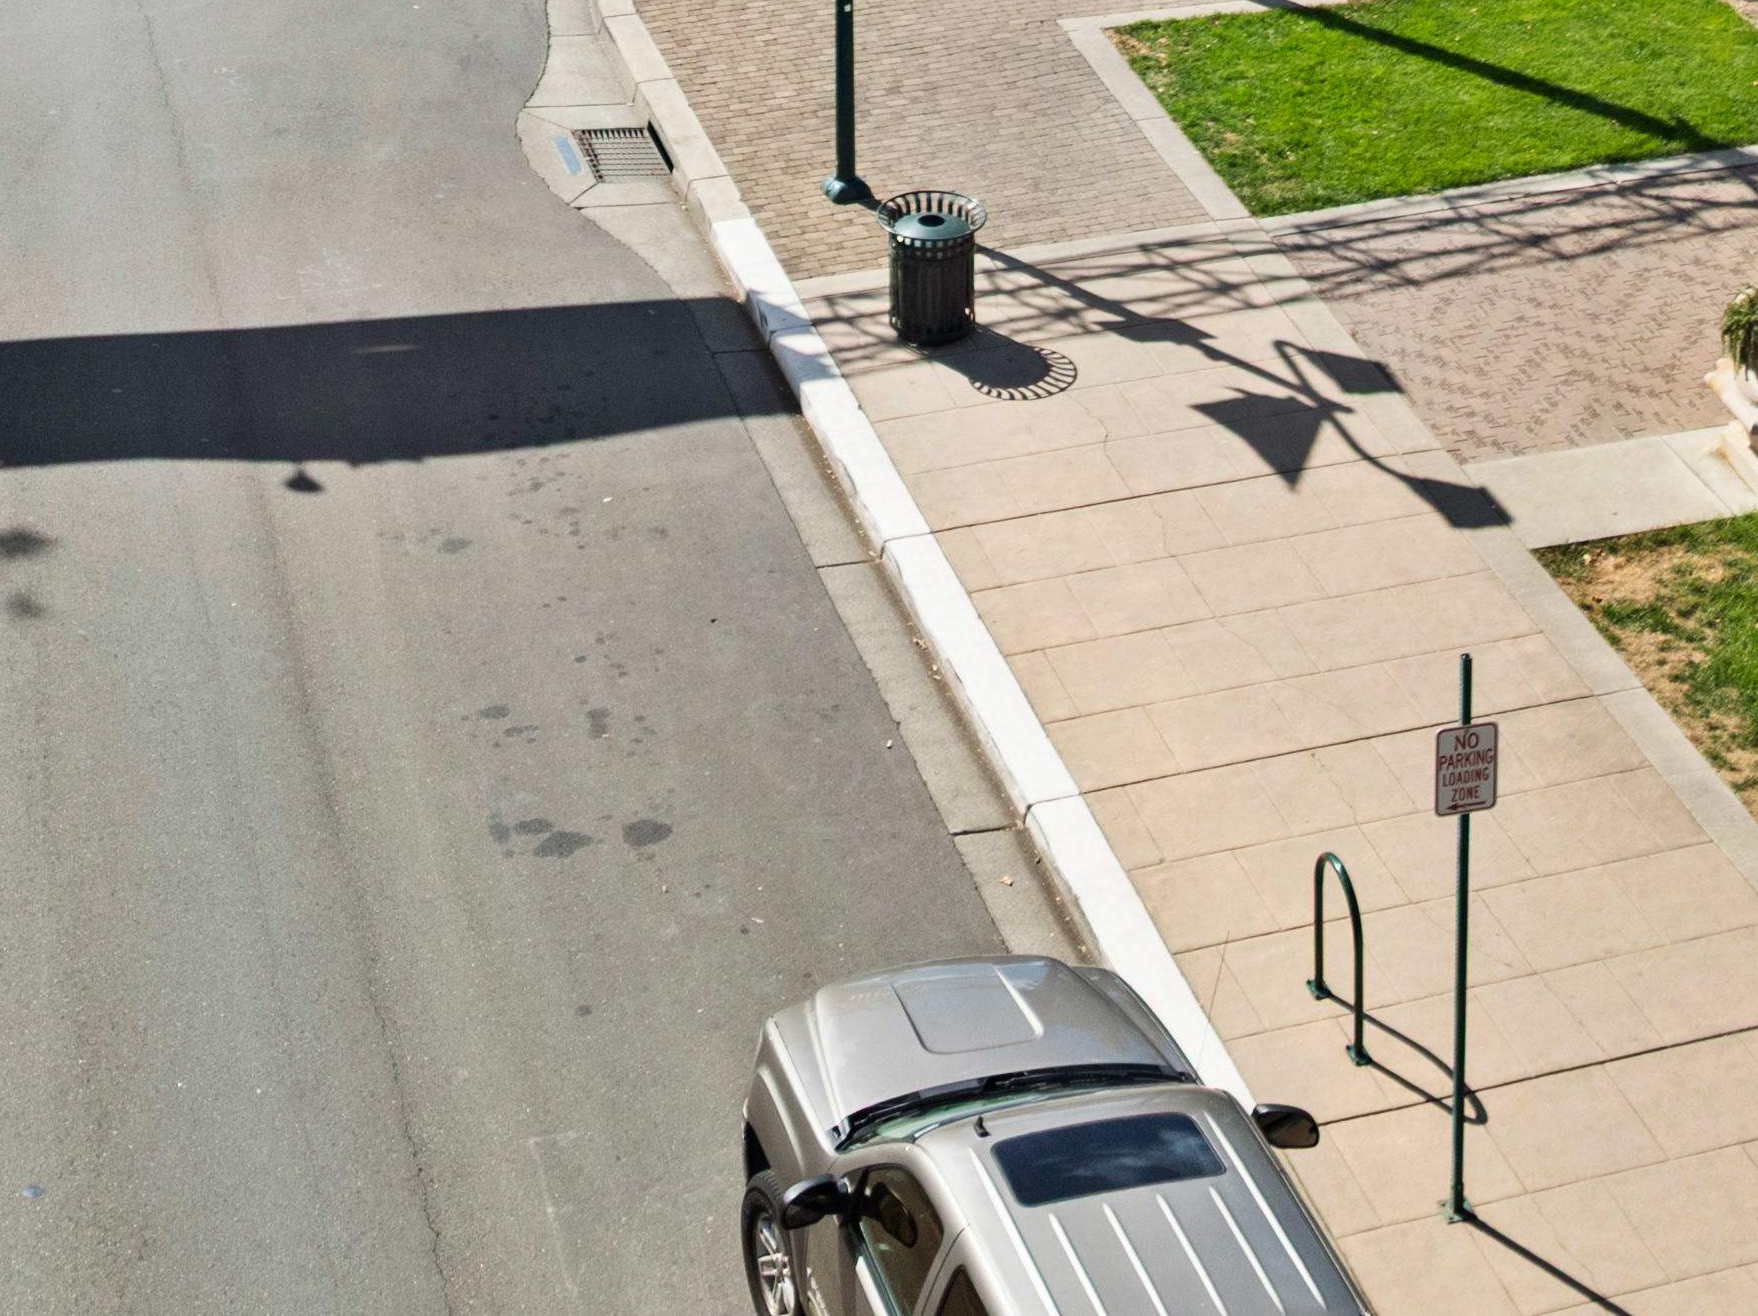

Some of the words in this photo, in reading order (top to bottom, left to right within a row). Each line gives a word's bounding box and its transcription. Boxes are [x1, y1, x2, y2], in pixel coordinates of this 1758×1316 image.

[1454, 732, 1480, 751] NO
[1438, 748, 1494, 771] PARKING
[1442, 766, 1491, 787] LOADING
[1451, 785, 1481, 803] ZONE
